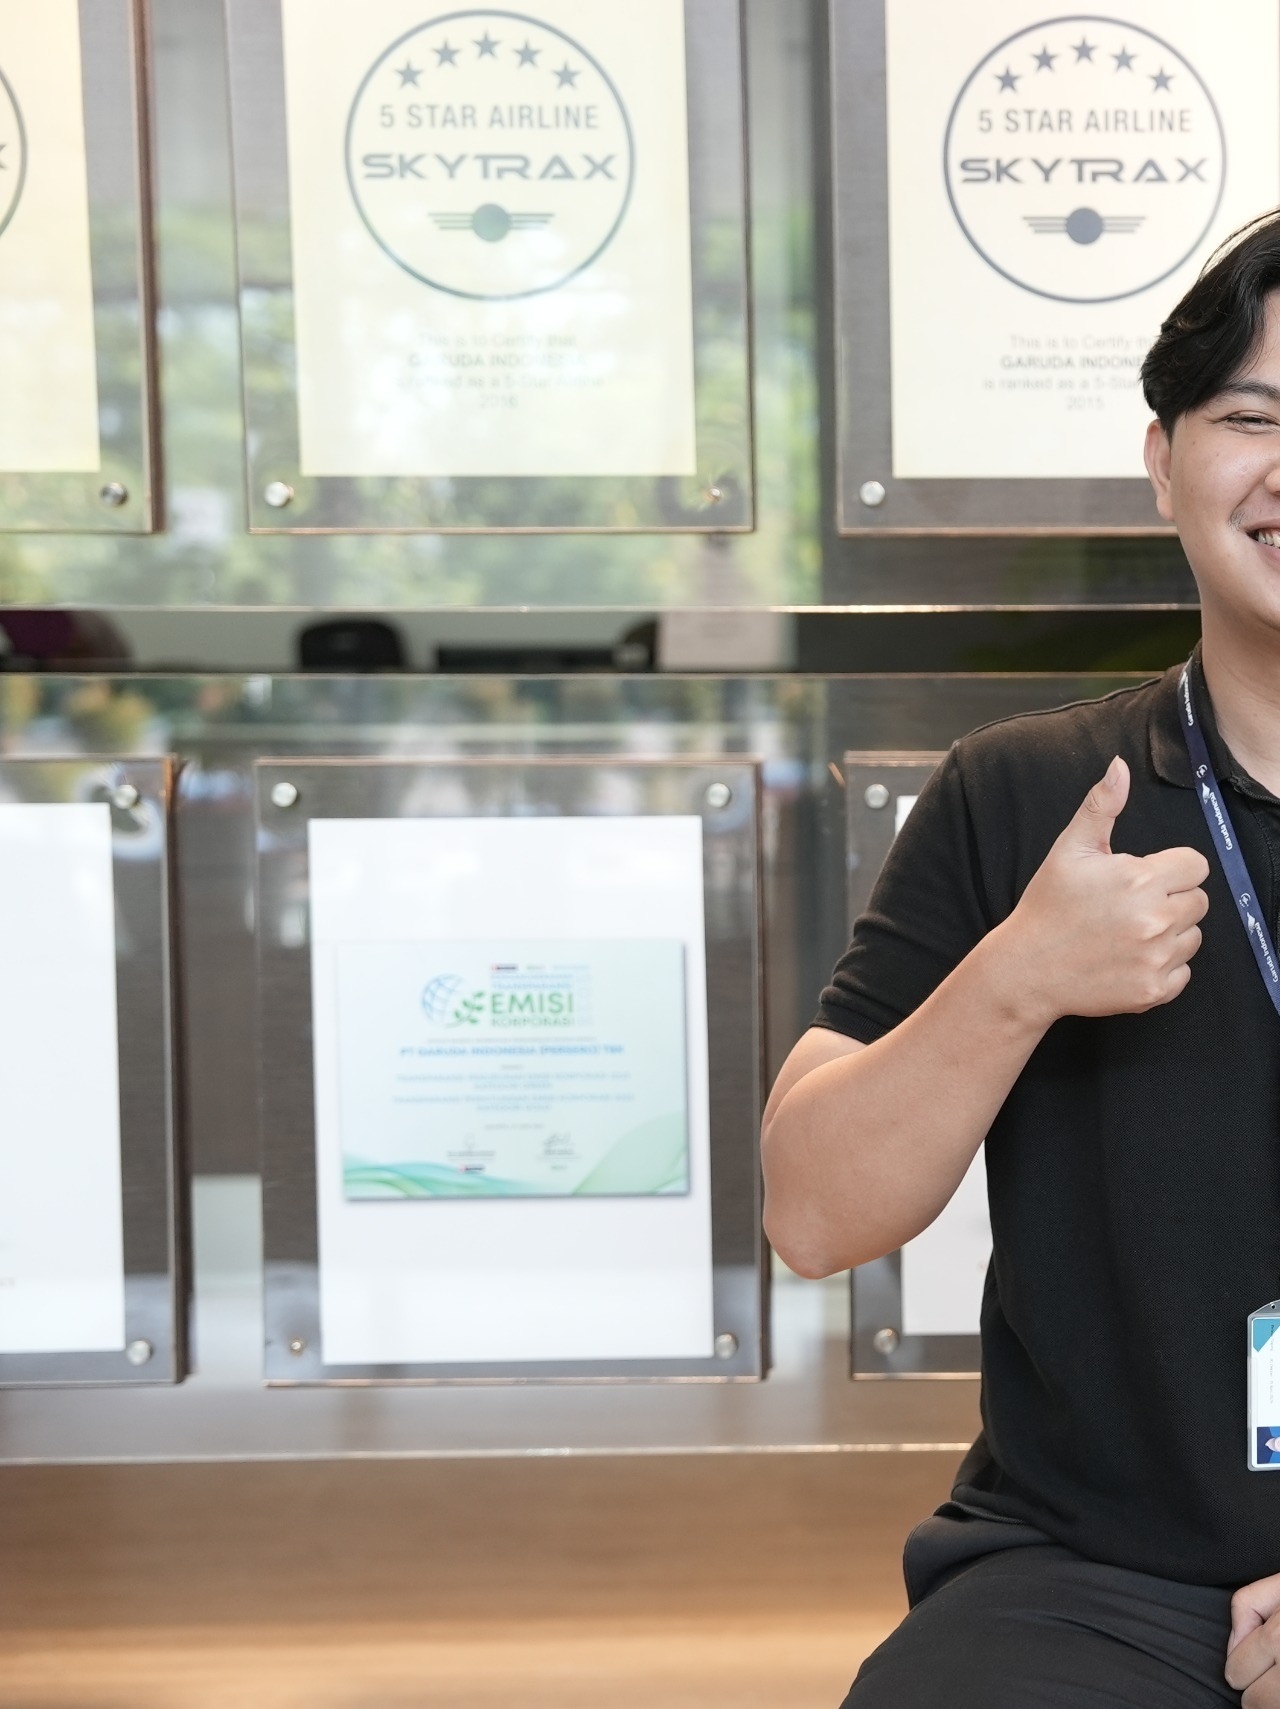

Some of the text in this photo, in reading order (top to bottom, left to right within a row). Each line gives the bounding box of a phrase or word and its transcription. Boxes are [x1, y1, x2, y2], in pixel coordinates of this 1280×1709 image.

[380, 103, 600, 129] 5 STAR AIRLINE
[978, 109, 1192, 133] 5 STAR AIRLINE
[362, 152, 617, 180] SKYTRAX
[960, 156, 1208, 184] SKYTRAX
[1010, 333, 1041, 349] This
[1047, 334, 1058, 349] is
[1062, 334, 1079, 349] to
[1081, 333, 1131, 352] Certify
[407, 353, 485, 368] GRUDA
[1000, 354, 1145, 370] GARUDA INDONE
[1209, 791, 1233, 851] Garuda Indonesia
[1254, 921, 1279, 983] Garuda Indonesia
[490, 992, 575, 1014] EMISI
